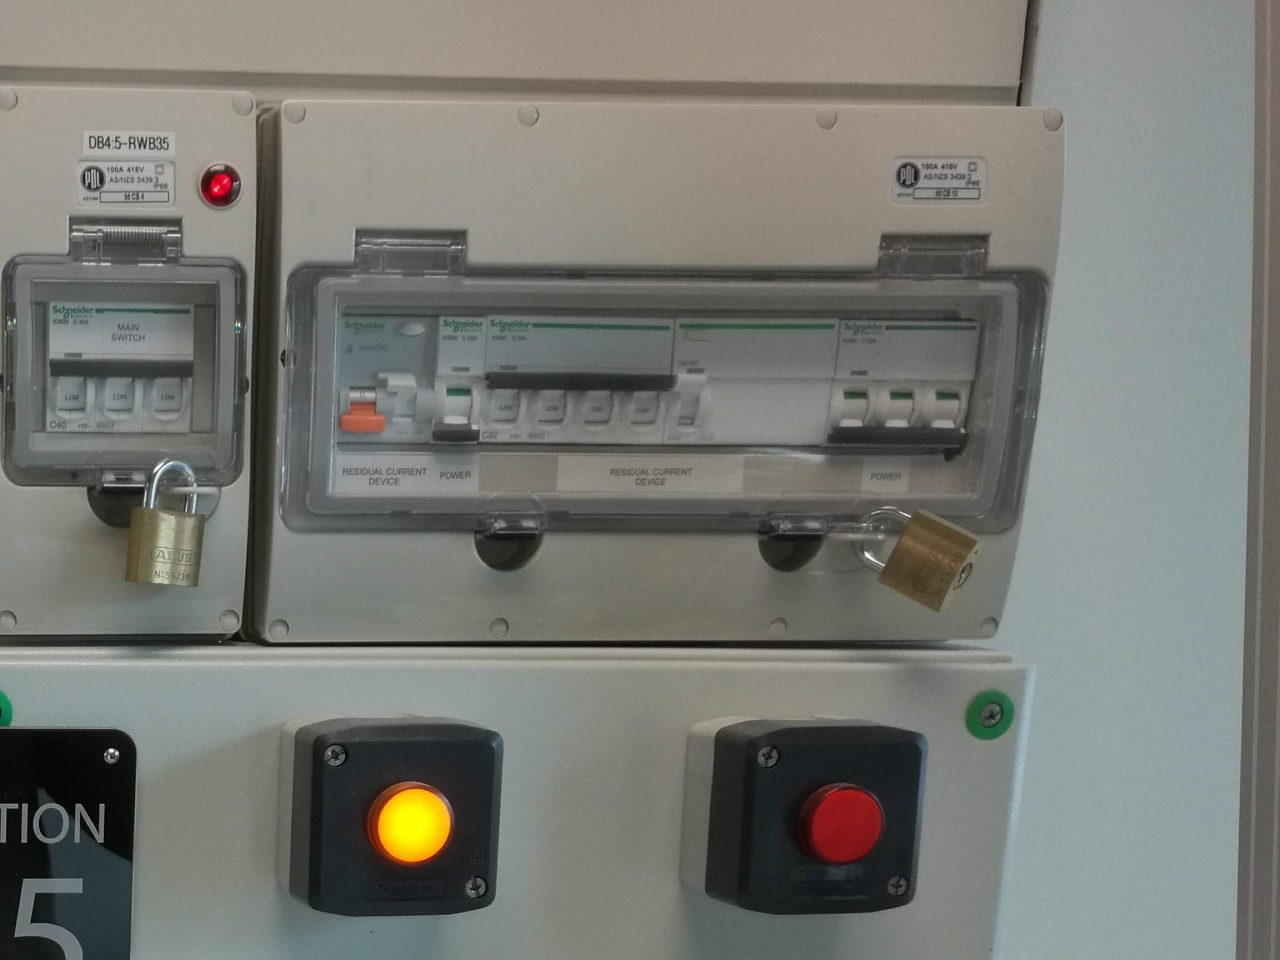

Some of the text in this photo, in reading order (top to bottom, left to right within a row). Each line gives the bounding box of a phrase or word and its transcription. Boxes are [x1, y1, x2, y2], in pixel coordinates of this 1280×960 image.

[52, 305, 95, 319] Schneider
[117, 323, 140, 332] MAIN
[442, 319, 484, 333] Schneider
[490, 319, 531, 332] Schneider
[111, 333, 146, 342] SWITCH
[49, 420, 67, 429] C40
[482, 431, 498, 439] C32
[342, 467, 427, 476] RESIDUAL CURRENT
[439, 471, 471, 480] POWER
[610, 468, 693, 476] RESIDUAL CURRENT
[870, 472, 901, 481] POWER
[368, 477, 400, 486] DEVICE
[635, 477, 666, 486] DEVICE
